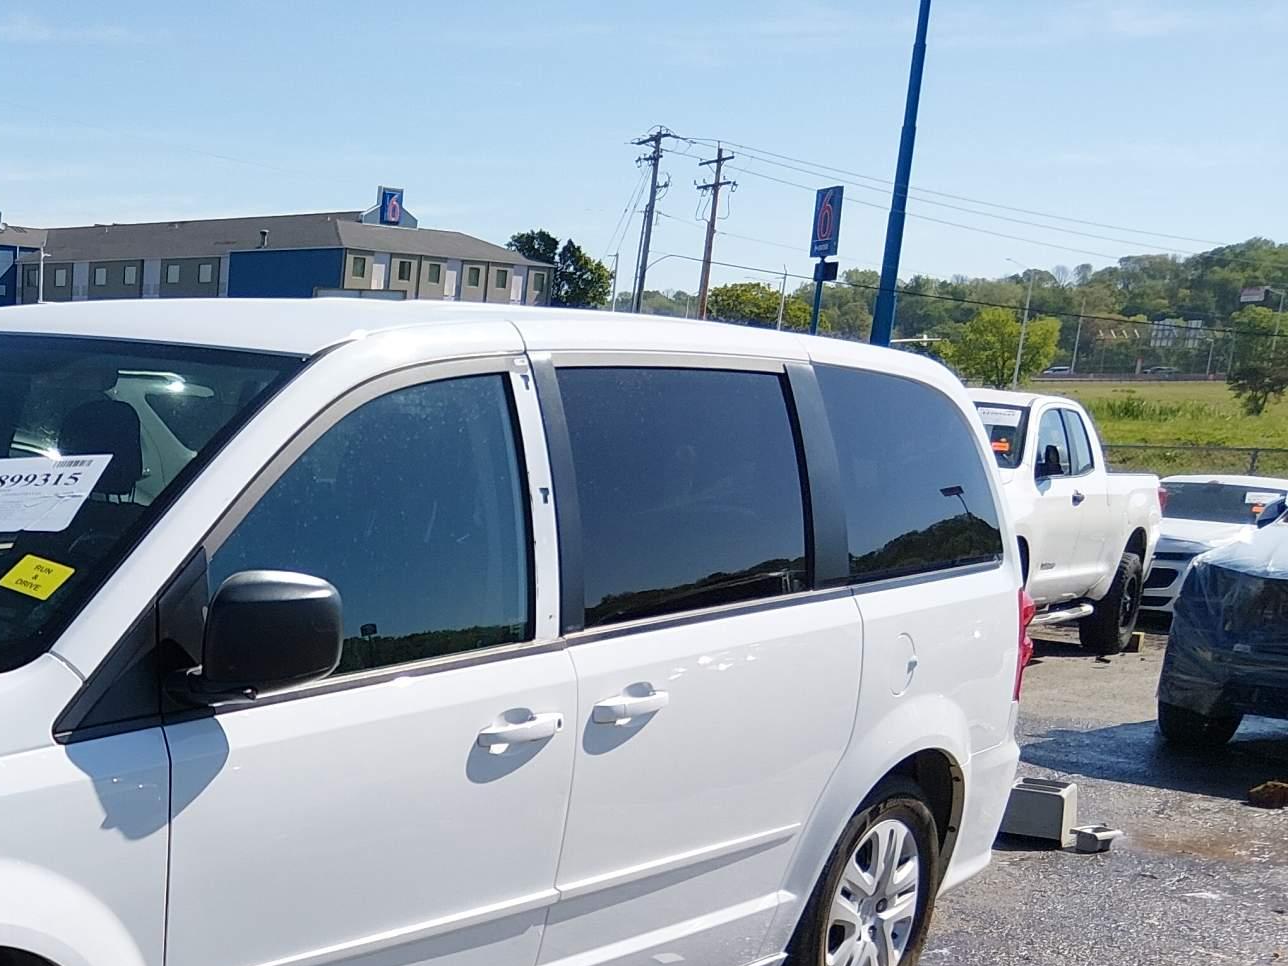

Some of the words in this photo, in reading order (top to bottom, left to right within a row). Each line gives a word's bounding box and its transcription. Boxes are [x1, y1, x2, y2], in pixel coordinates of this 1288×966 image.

[817, 189, 833, 241] 6
[33, 564, 53, 575] RUN
[15, 578, 42, 592] DRIVE
